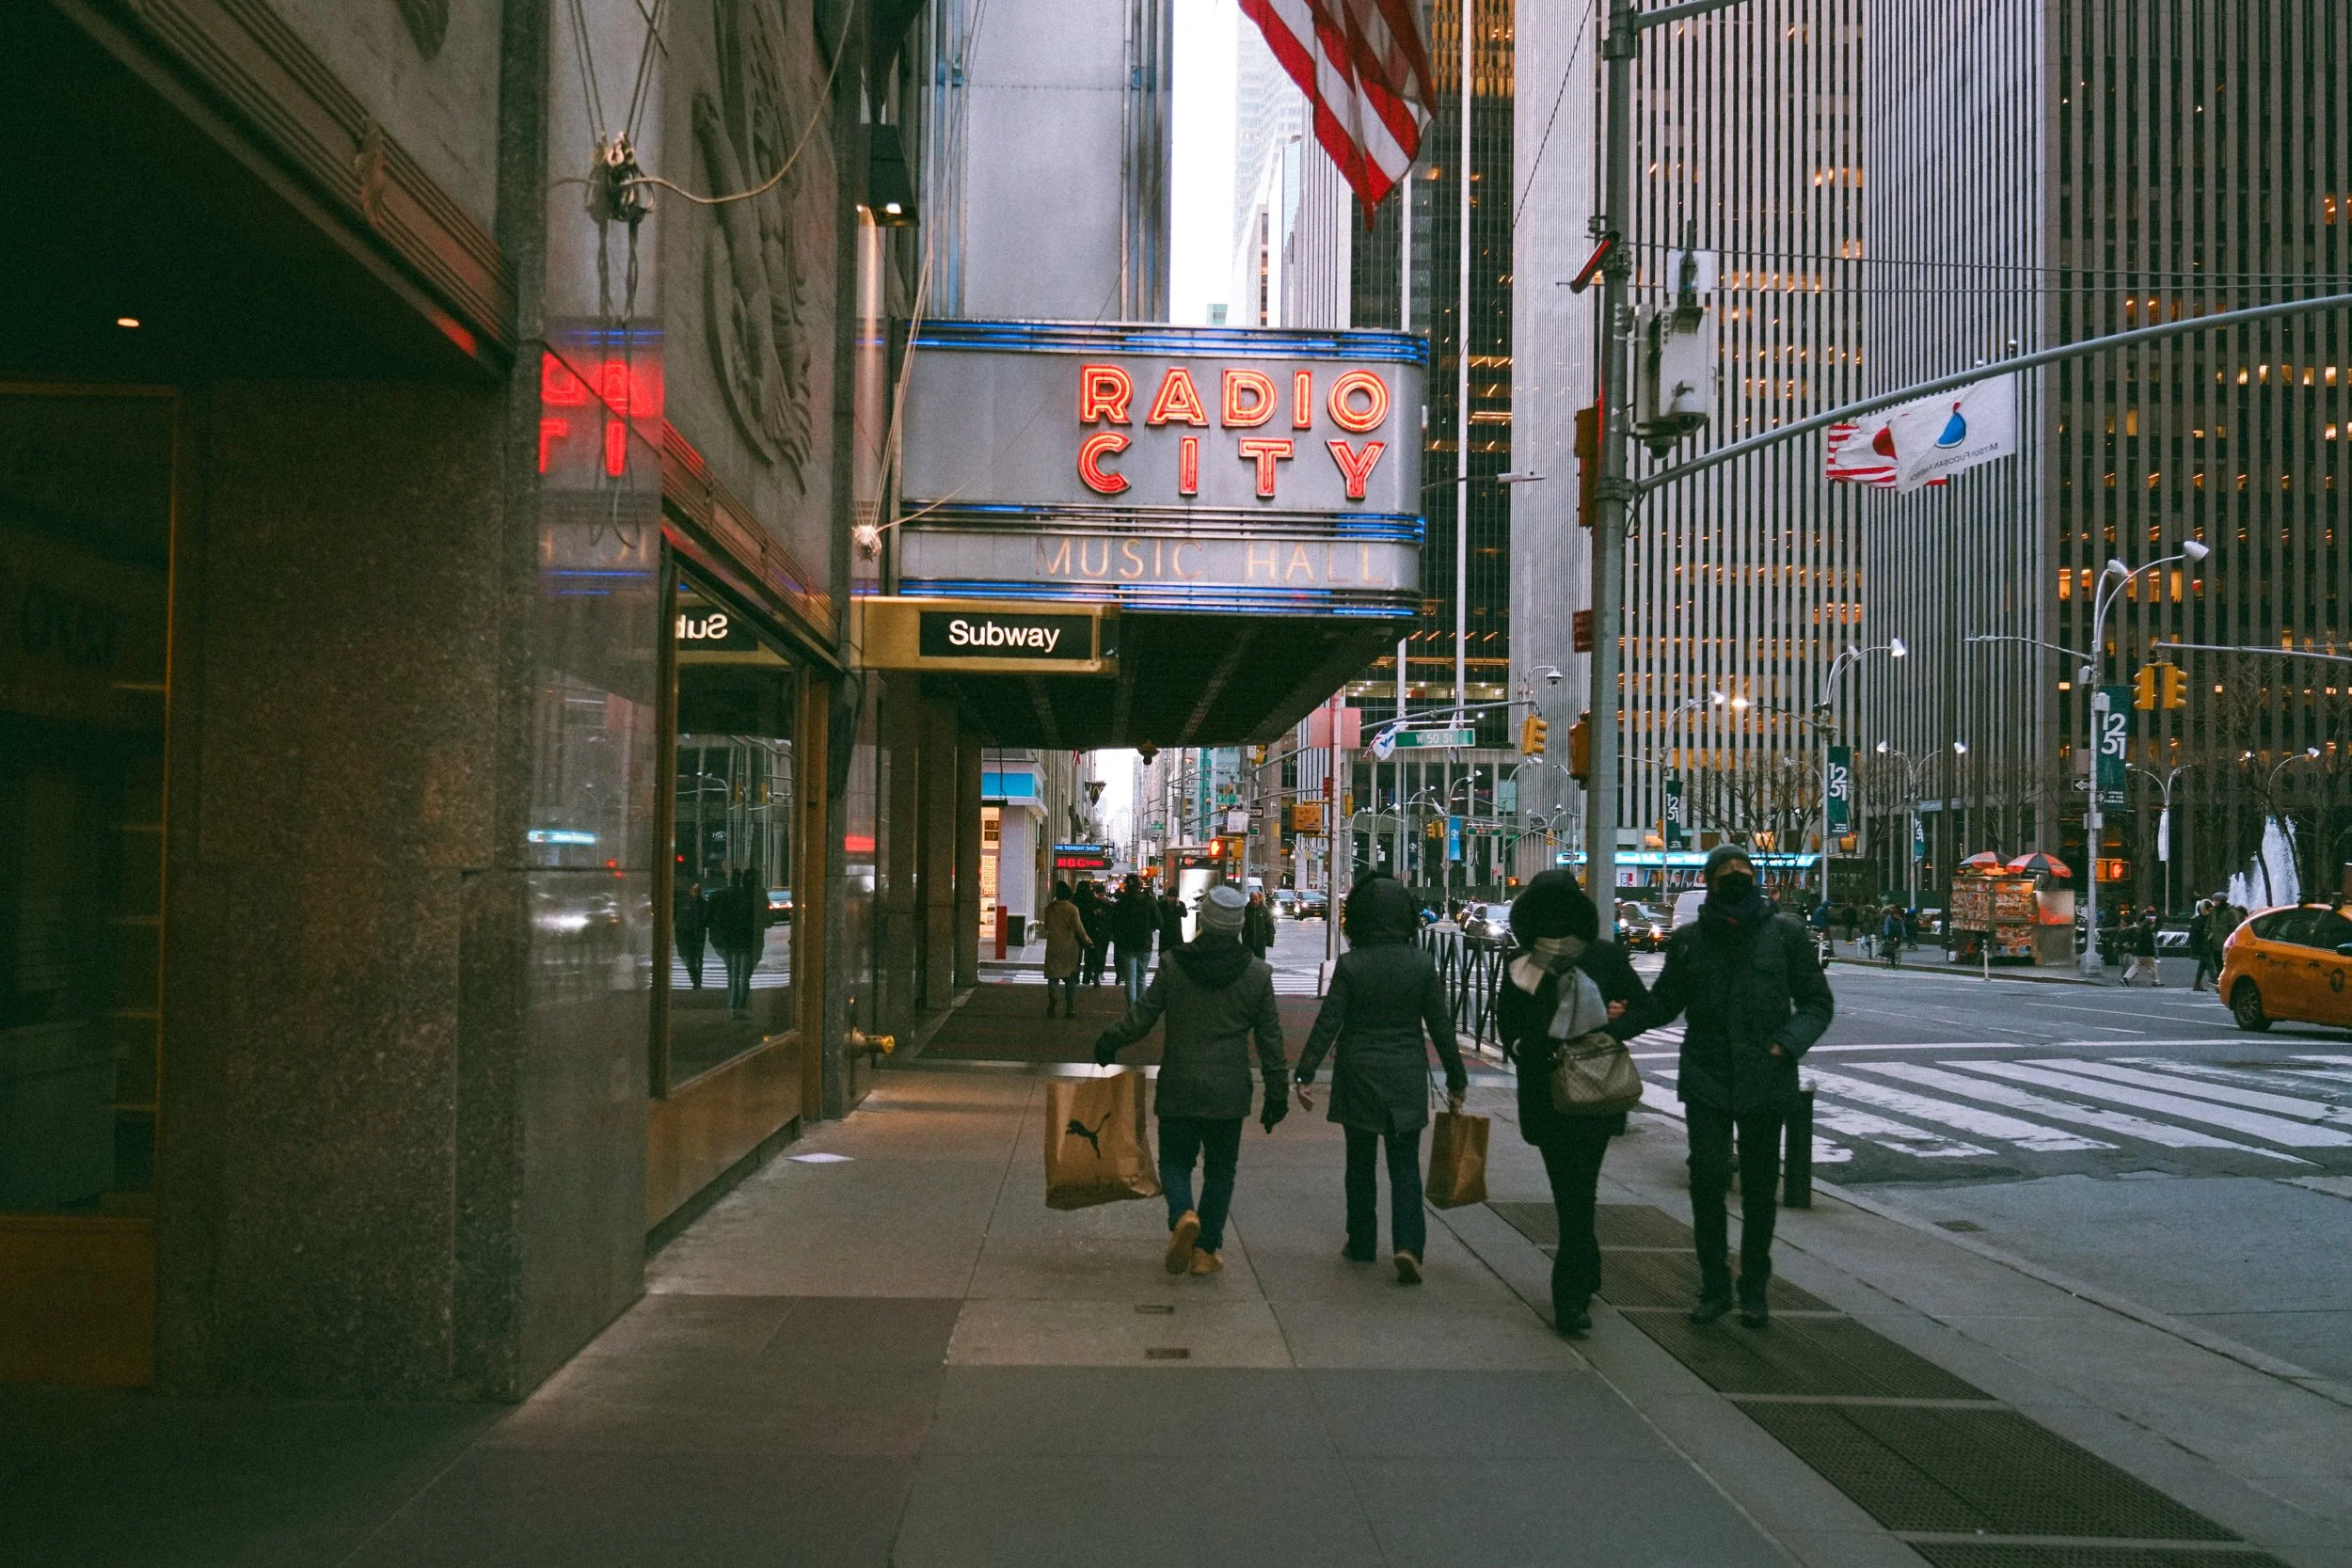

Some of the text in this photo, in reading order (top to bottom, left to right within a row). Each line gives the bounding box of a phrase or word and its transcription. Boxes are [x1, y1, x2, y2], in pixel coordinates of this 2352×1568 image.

[1080, 365, 1390, 432] RADIO
[1078, 432, 1387, 499] CITY
[1037, 538, 1385, 583] MUSIC HALL
[948, 620, 1059, 653] Subway
[1415, 733, 1454, 744] W 50 St
[1057, 858, 1086, 868] NBC
